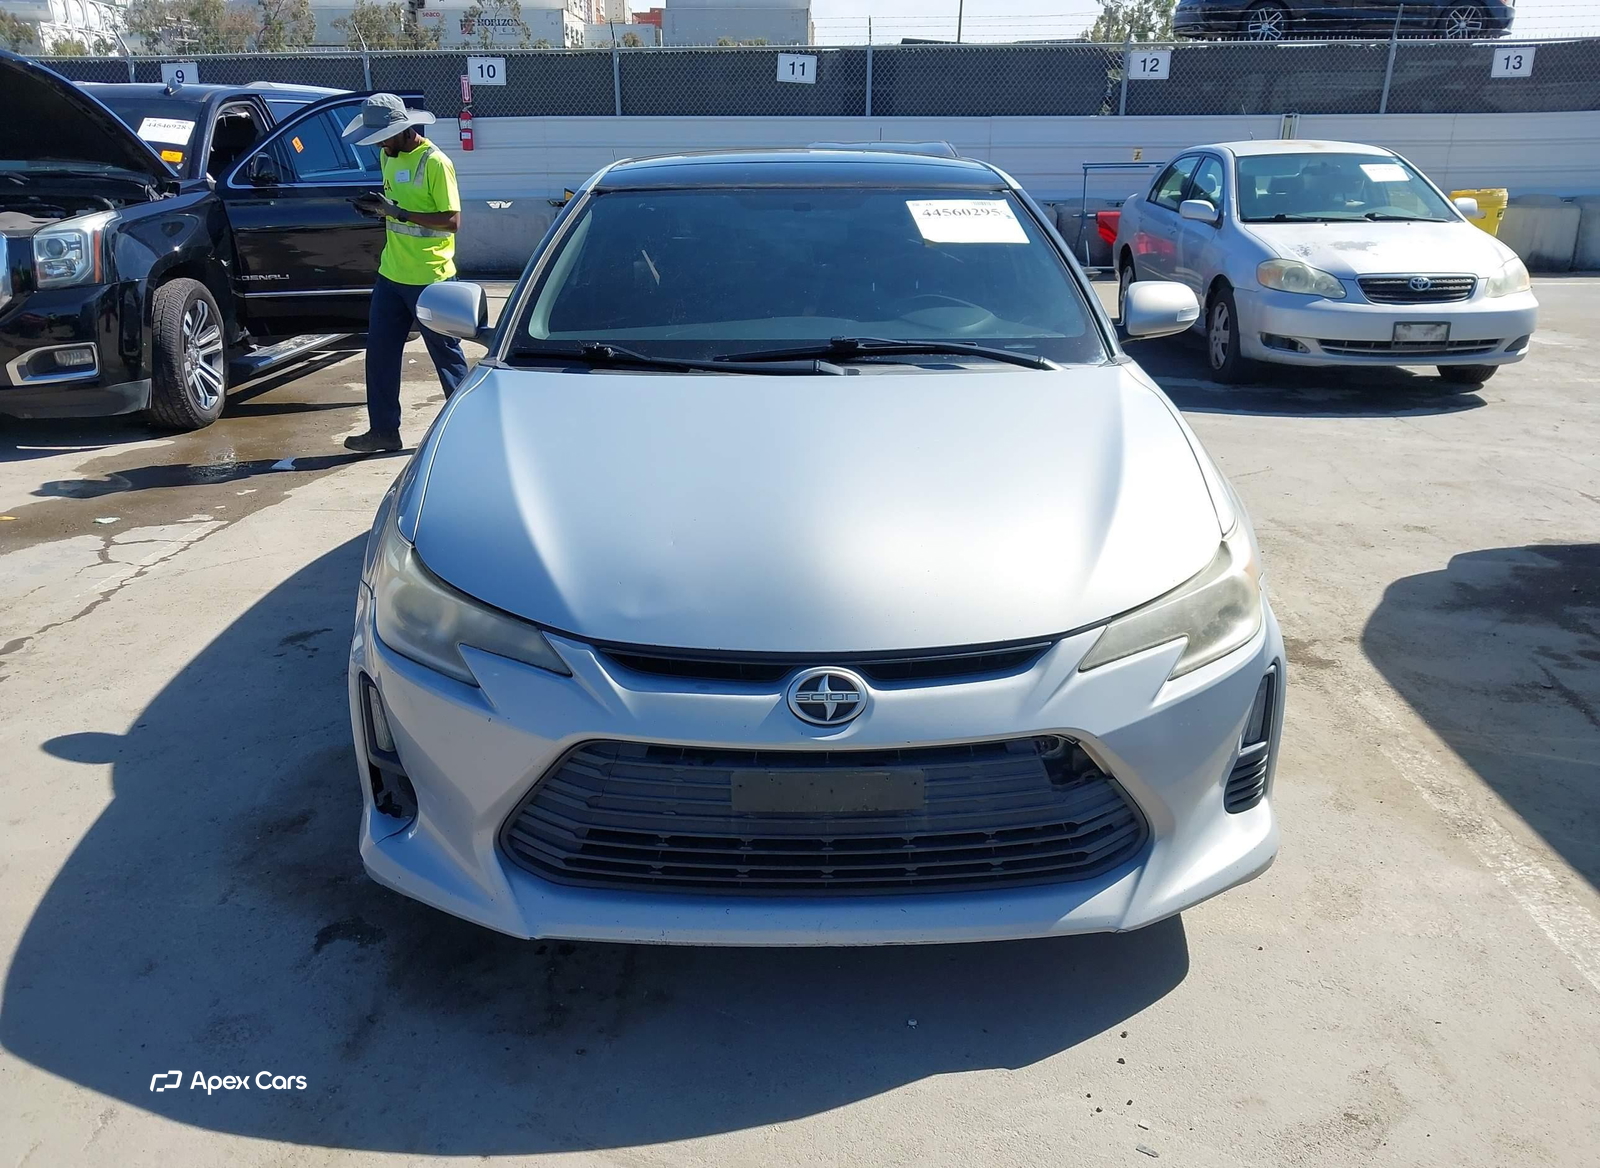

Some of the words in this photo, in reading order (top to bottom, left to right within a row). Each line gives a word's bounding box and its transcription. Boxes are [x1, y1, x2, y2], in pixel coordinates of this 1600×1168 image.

[789, 61, 806, 76] 11
[1140, 57, 1160, 73] 12
[1503, 54, 1523, 70] 13
[175, 69, 185, 83] 9
[477, 63, 496, 79] 10
[922, 208, 1001, 217] 44560295
